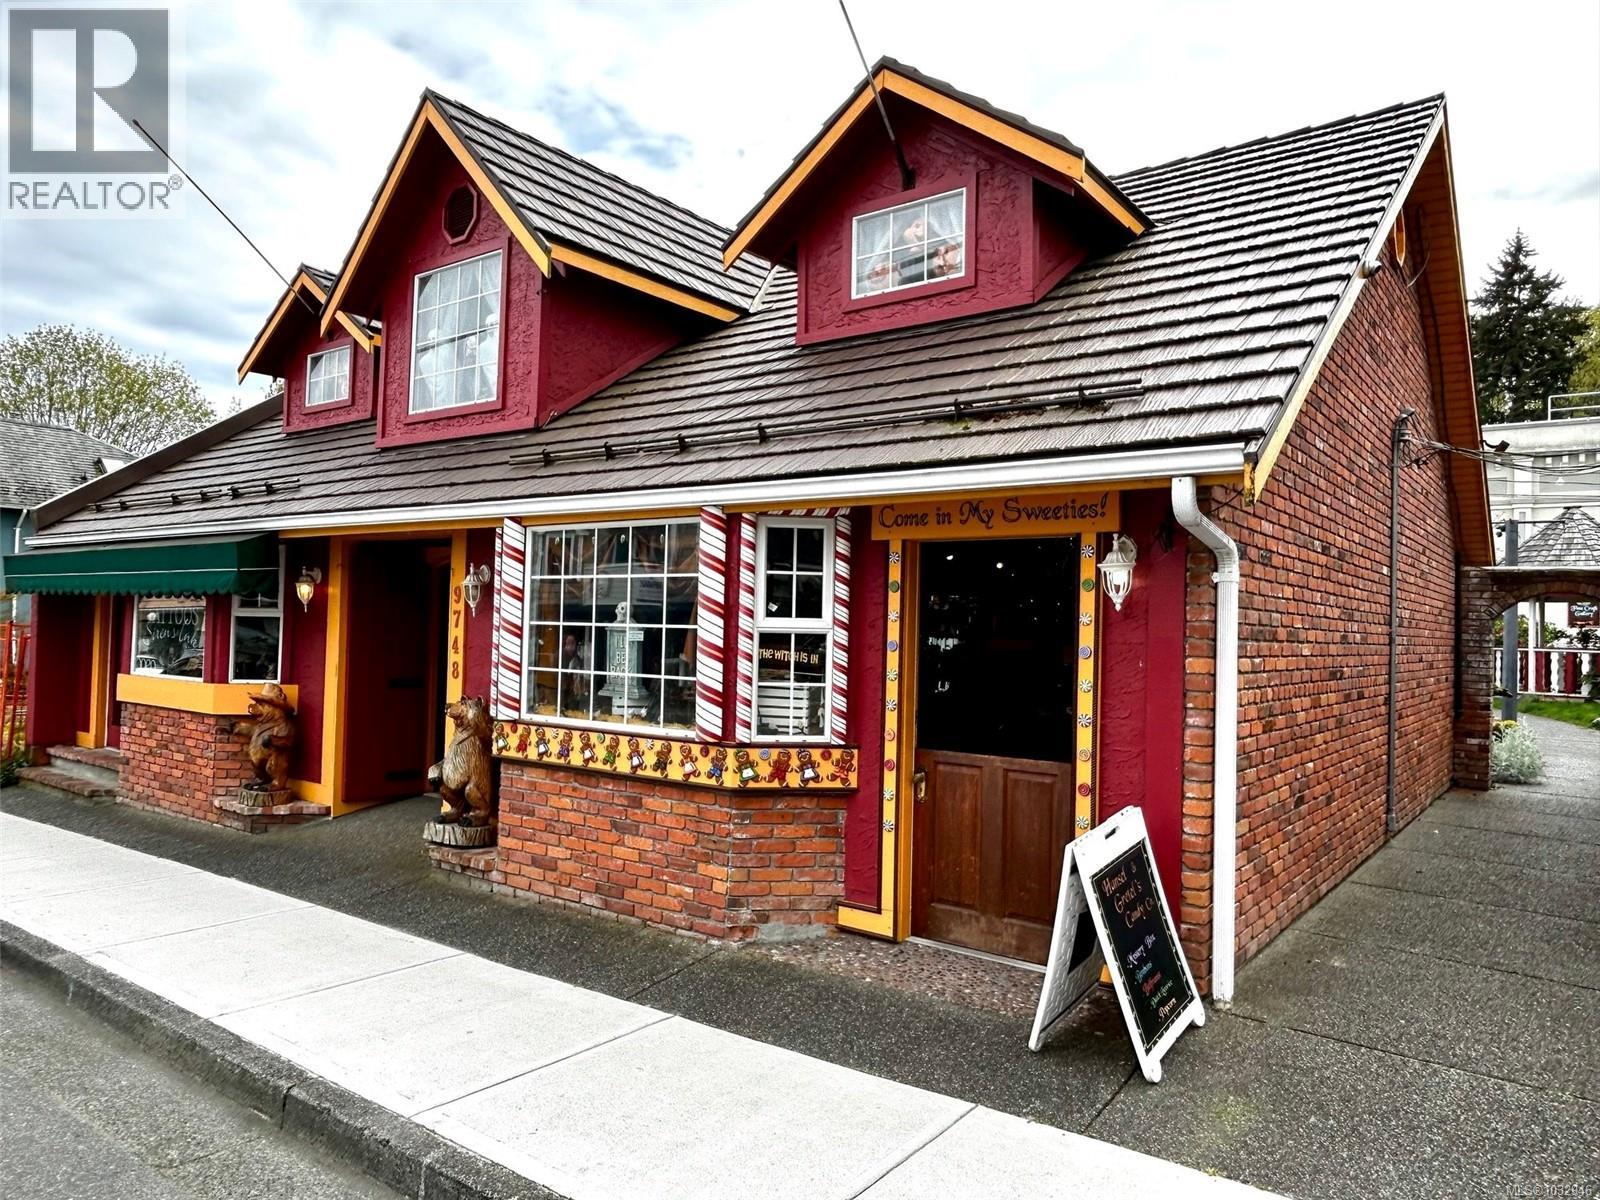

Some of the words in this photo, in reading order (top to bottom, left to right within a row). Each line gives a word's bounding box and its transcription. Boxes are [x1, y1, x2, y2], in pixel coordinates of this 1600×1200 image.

[878, 504, 929, 528] Come
[935, 507, 953, 525] in
[959, 500, 995, 529] My
[1002, 491, 1108, 523] Sweeties!
[147, 609, 199, 625] ATTOOS
[452, 586, 461, 679] 9748
[800, 652, 808, 663] IS
[810, 654, 819, 664] IN
